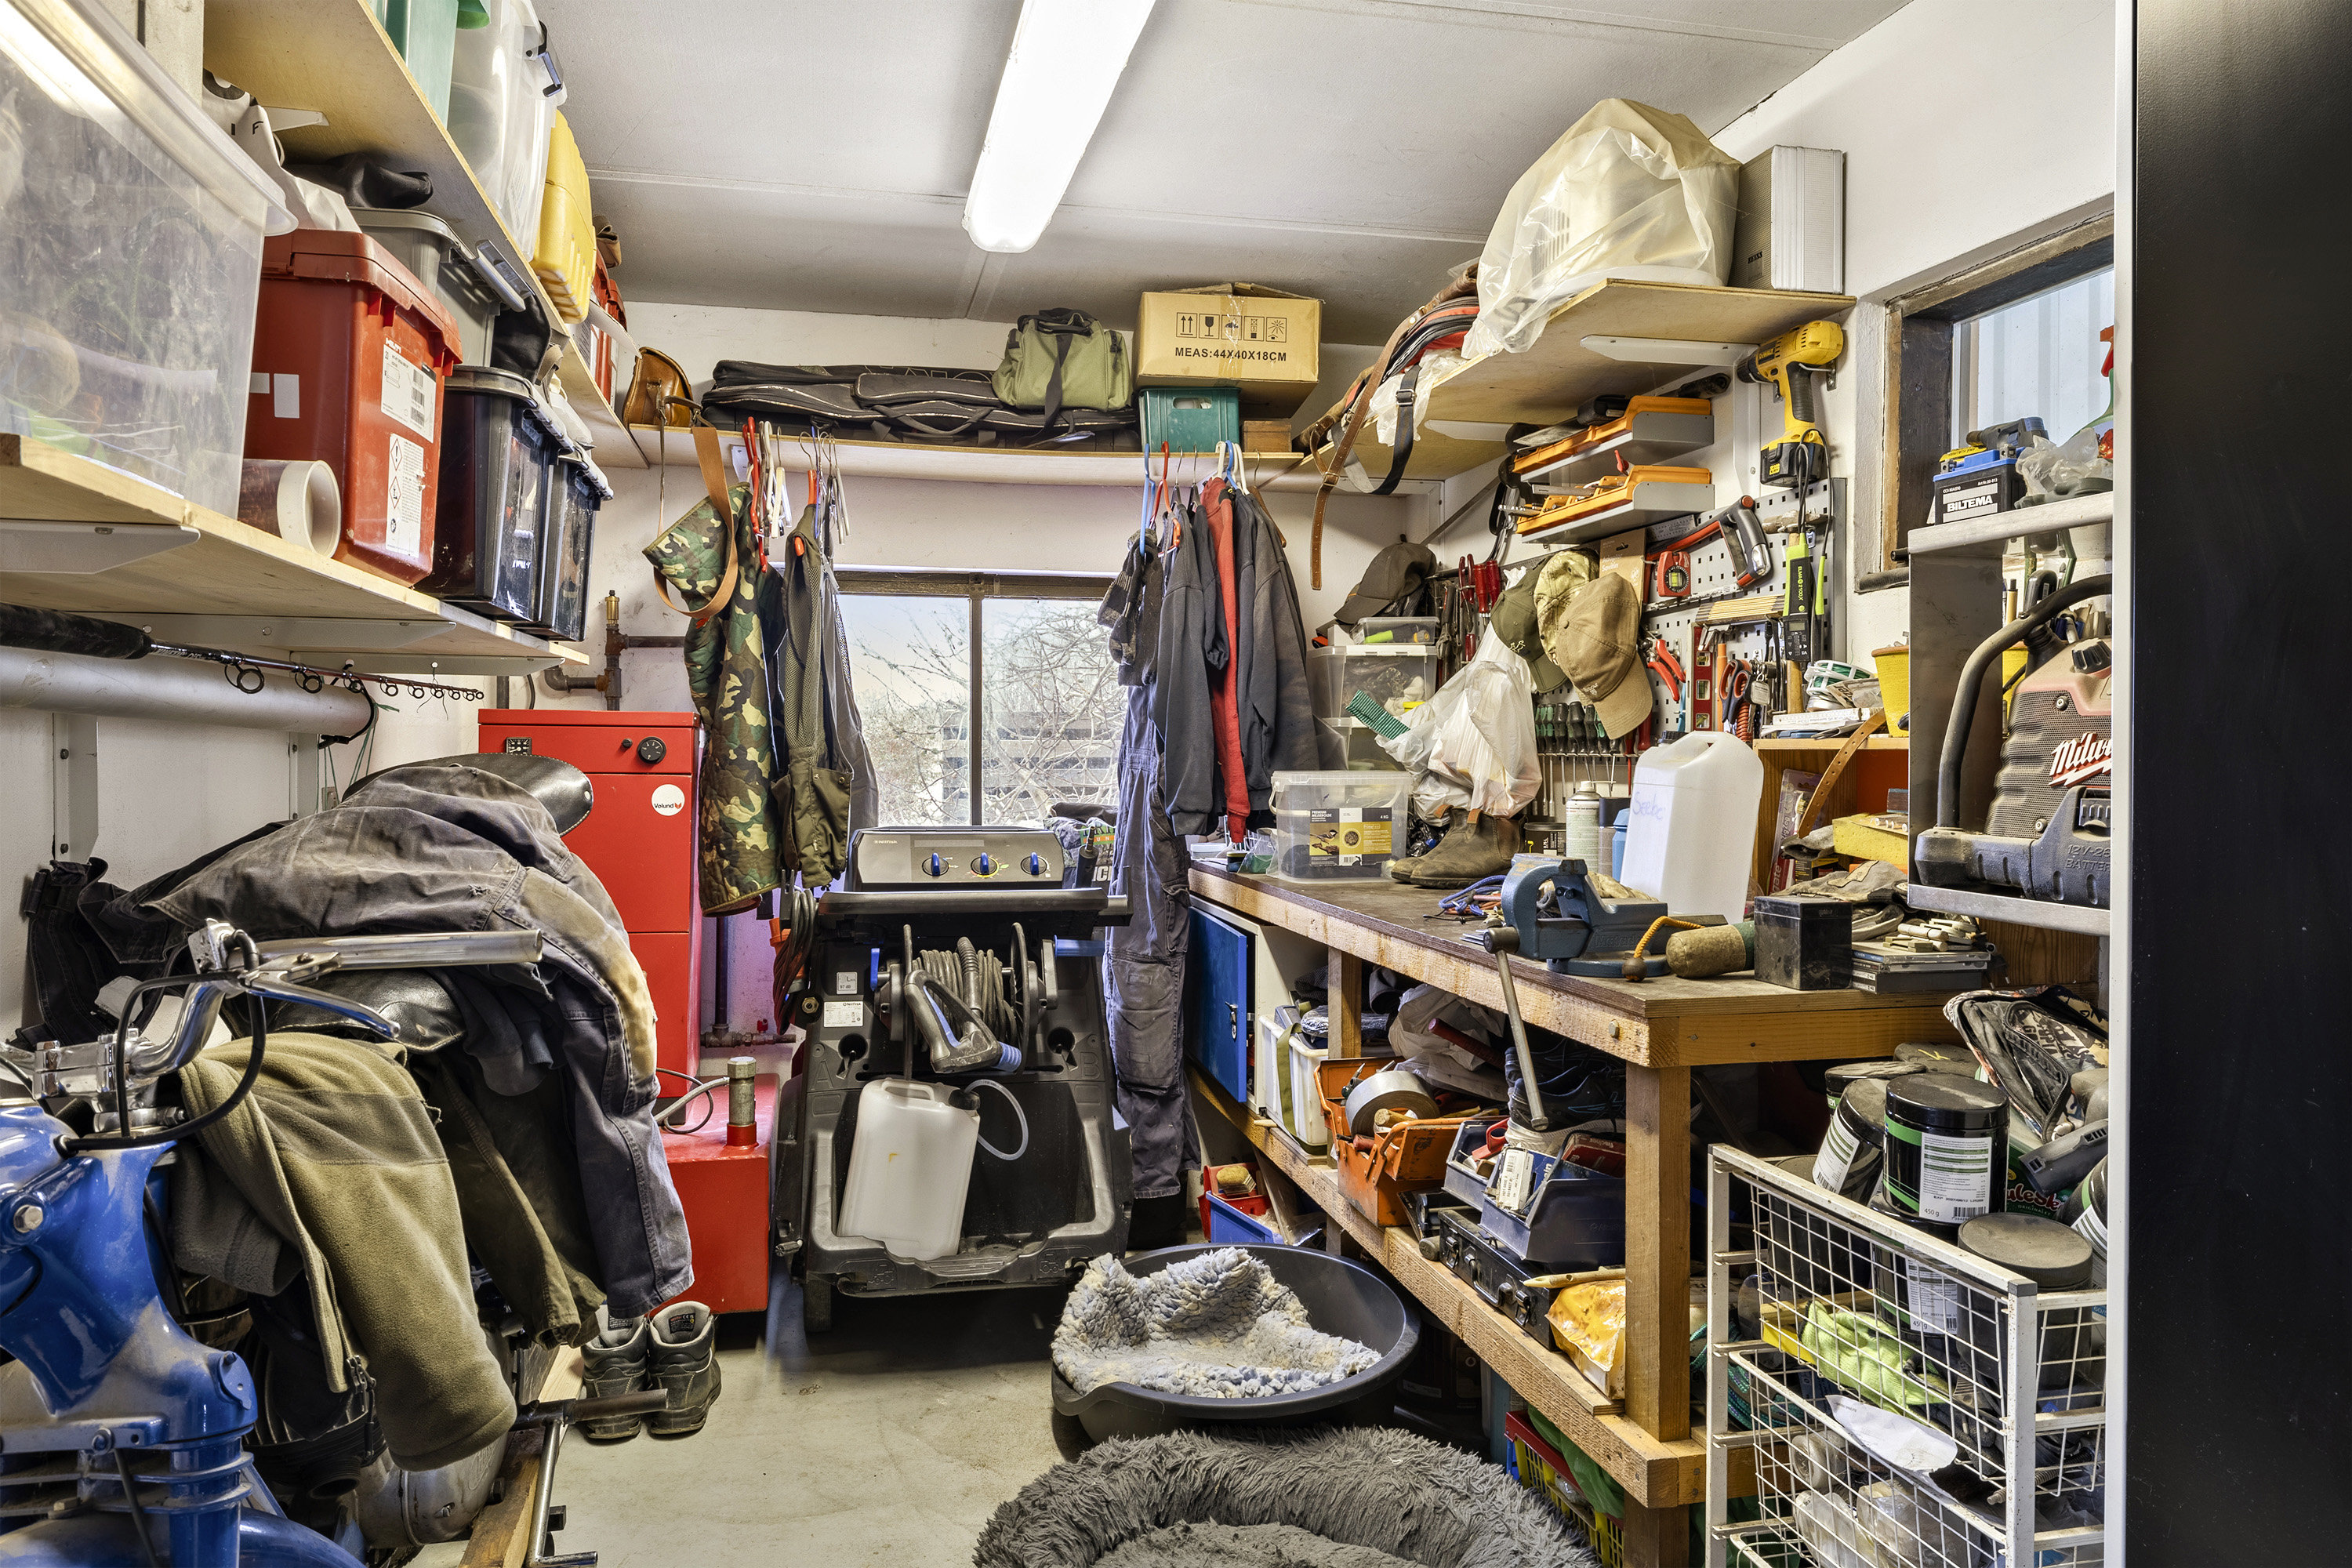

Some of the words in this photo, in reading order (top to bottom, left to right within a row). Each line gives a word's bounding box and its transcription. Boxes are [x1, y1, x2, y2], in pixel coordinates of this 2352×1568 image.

[1175, 347, 1287, 361] MEAS:44X40X18CM
[1947, 495, 1993, 513] BILTEMA
[1923, 1207, 1935, 1215] 450
